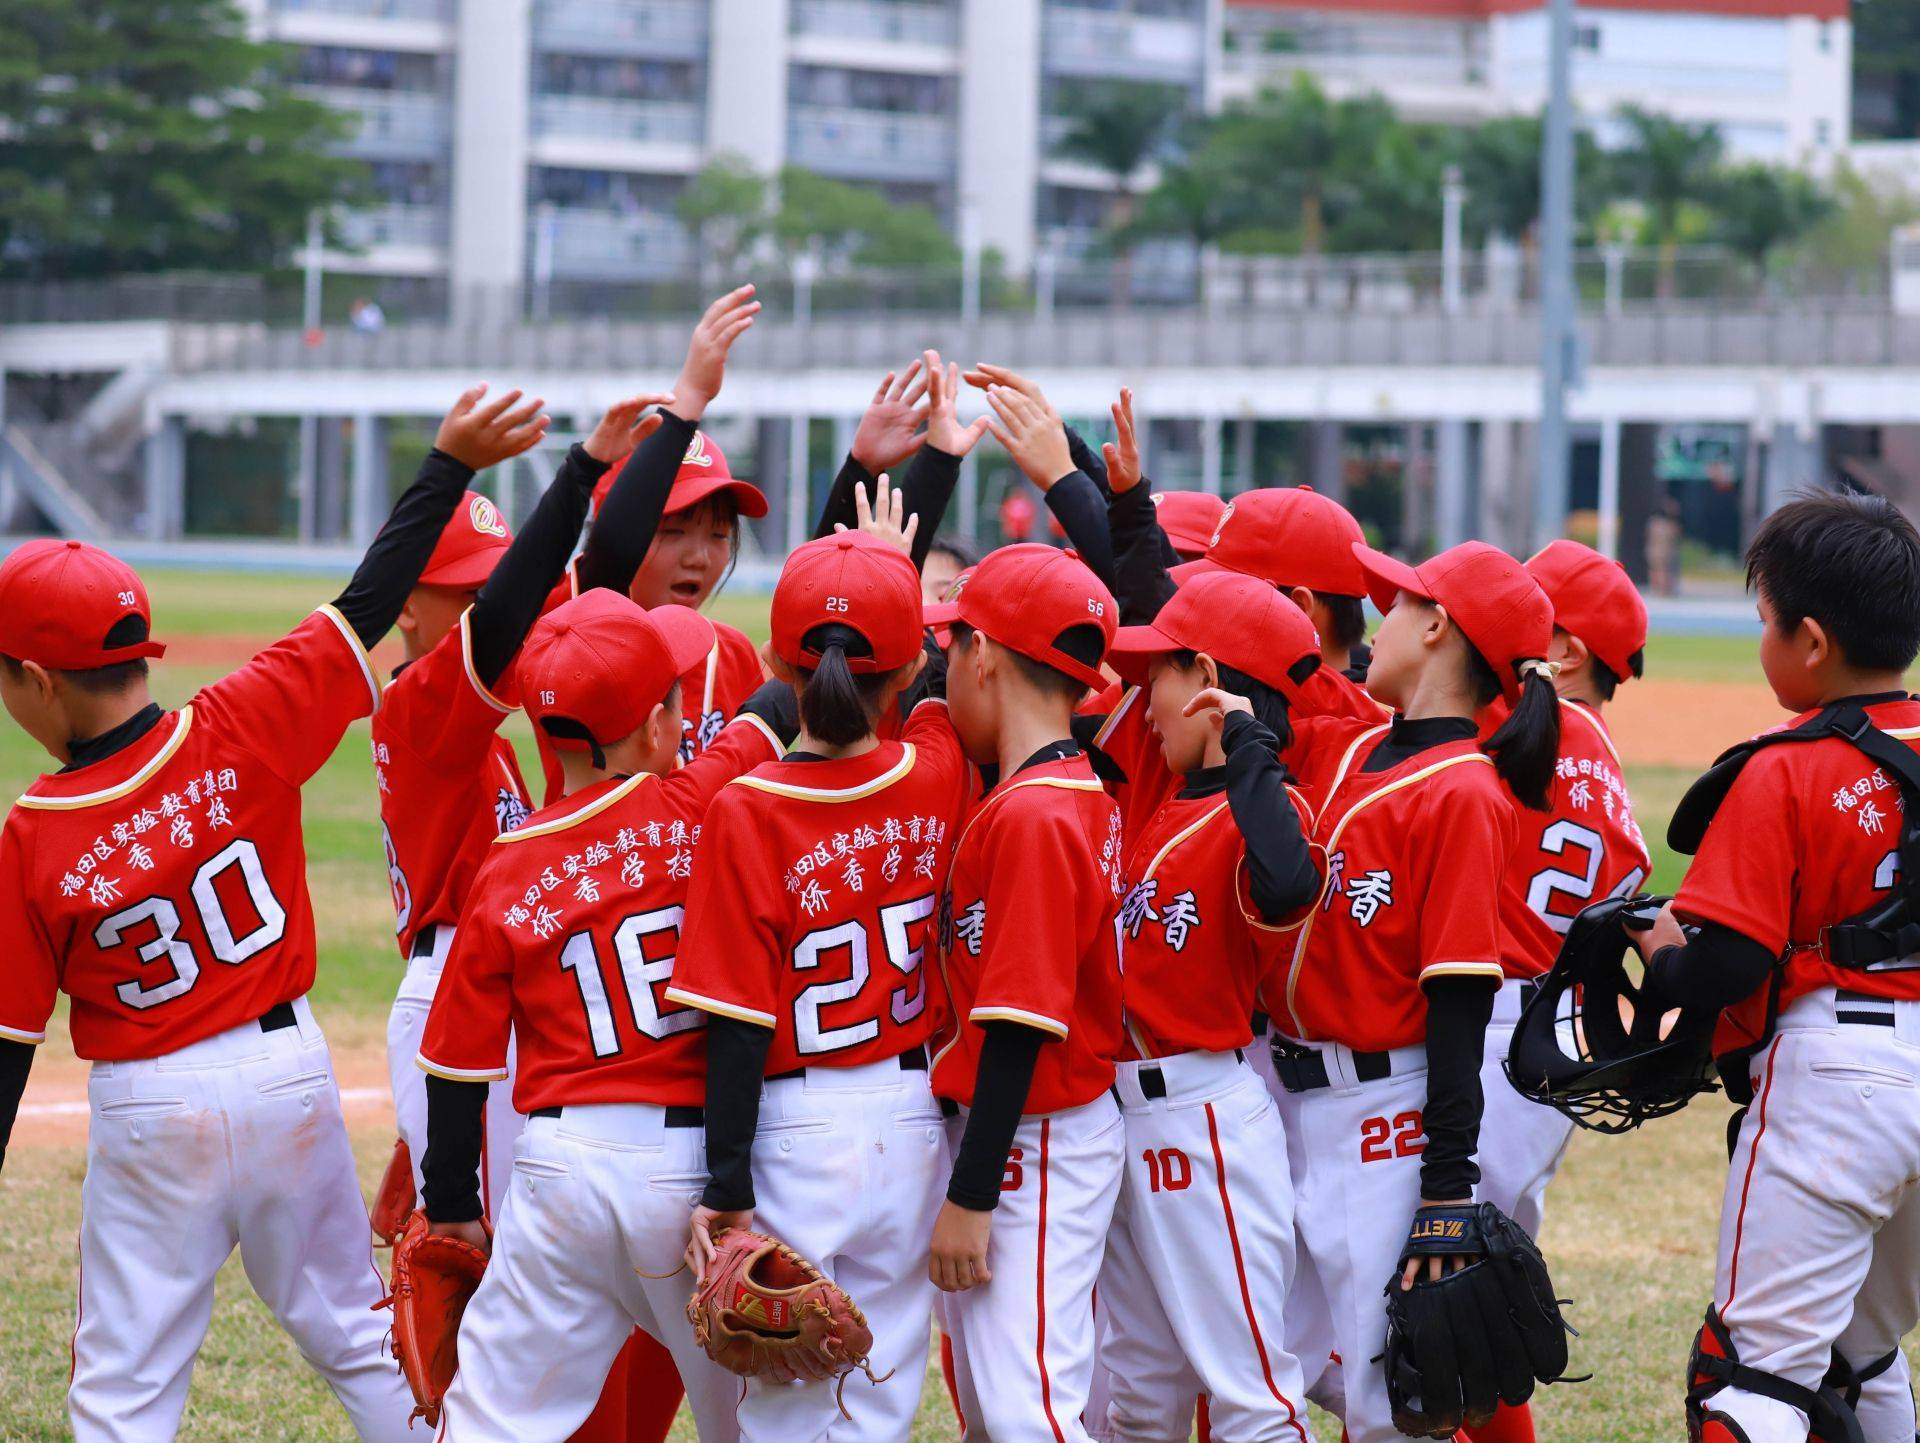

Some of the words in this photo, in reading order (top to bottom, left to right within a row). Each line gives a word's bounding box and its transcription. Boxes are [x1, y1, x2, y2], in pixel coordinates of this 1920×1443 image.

[118, 590, 135, 606] 30
[825, 597, 849, 612] 25
[1088, 598, 1104, 617] 56
[539, 690, 555, 705] 16
[1832, 768, 1898, 813] 福田区
[60, 768, 238, 897] 福田区实验教育集团
[87, 797, 233, 907] 侨香学校
[93, 837, 287, 1010] 30
[793, 892, 936, 1057] 25
[1360, 1110, 1428, 1163] 22
[1143, 1148, 1192, 1193] 10
[1411, 1220, 1464, 1239] ZETT
